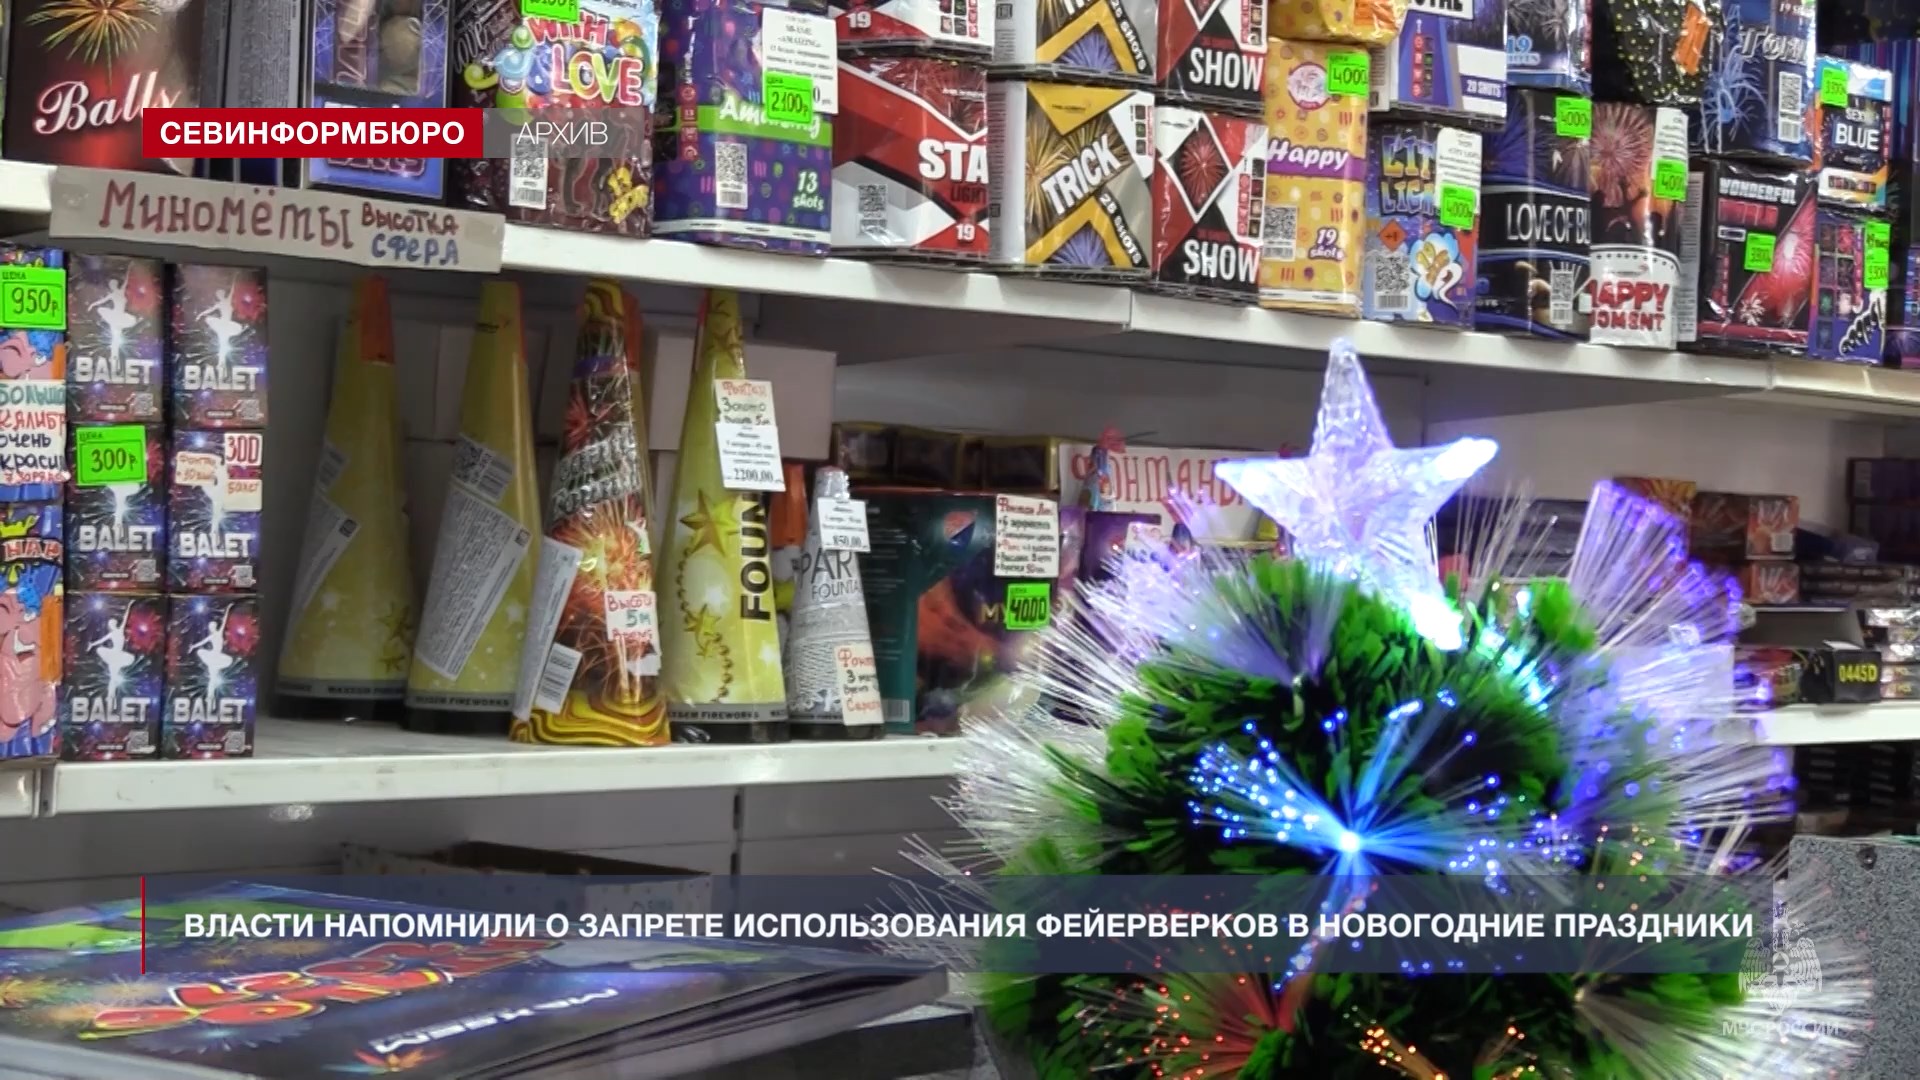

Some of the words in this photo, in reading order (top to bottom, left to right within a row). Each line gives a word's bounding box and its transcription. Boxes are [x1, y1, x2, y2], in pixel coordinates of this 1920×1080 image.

[848, 11, 872, 29] 19
[550, 43, 643, 106] LOVE
[1188, 48, 1264, 91] SHOW
[1834, 123, 1880, 151] BLUE
[1266, 139, 1350, 172] Happy
[798, 171, 818, 194] 13
[1041, 133, 1123, 216] TRICK
[1719, 177, 1797, 204] WONDERFUL
[956, 223, 976, 241] 19
[1507, 203, 1552, 243] LOVE
[1553, 205, 1574, 244] OF
[1316, 229, 1337, 246] 19
[1183, 239, 1260, 284] SHOW
[1588, 311, 1666, 332] OMENT
[75, 356, 155, 385] BALET
[183, 364, 261, 390] BALET
[79, 524, 157, 552] BALET
[178, 532, 256, 558] BALET
[71, 697, 150, 723] BALET
[173, 698, 248, 723] BALET
